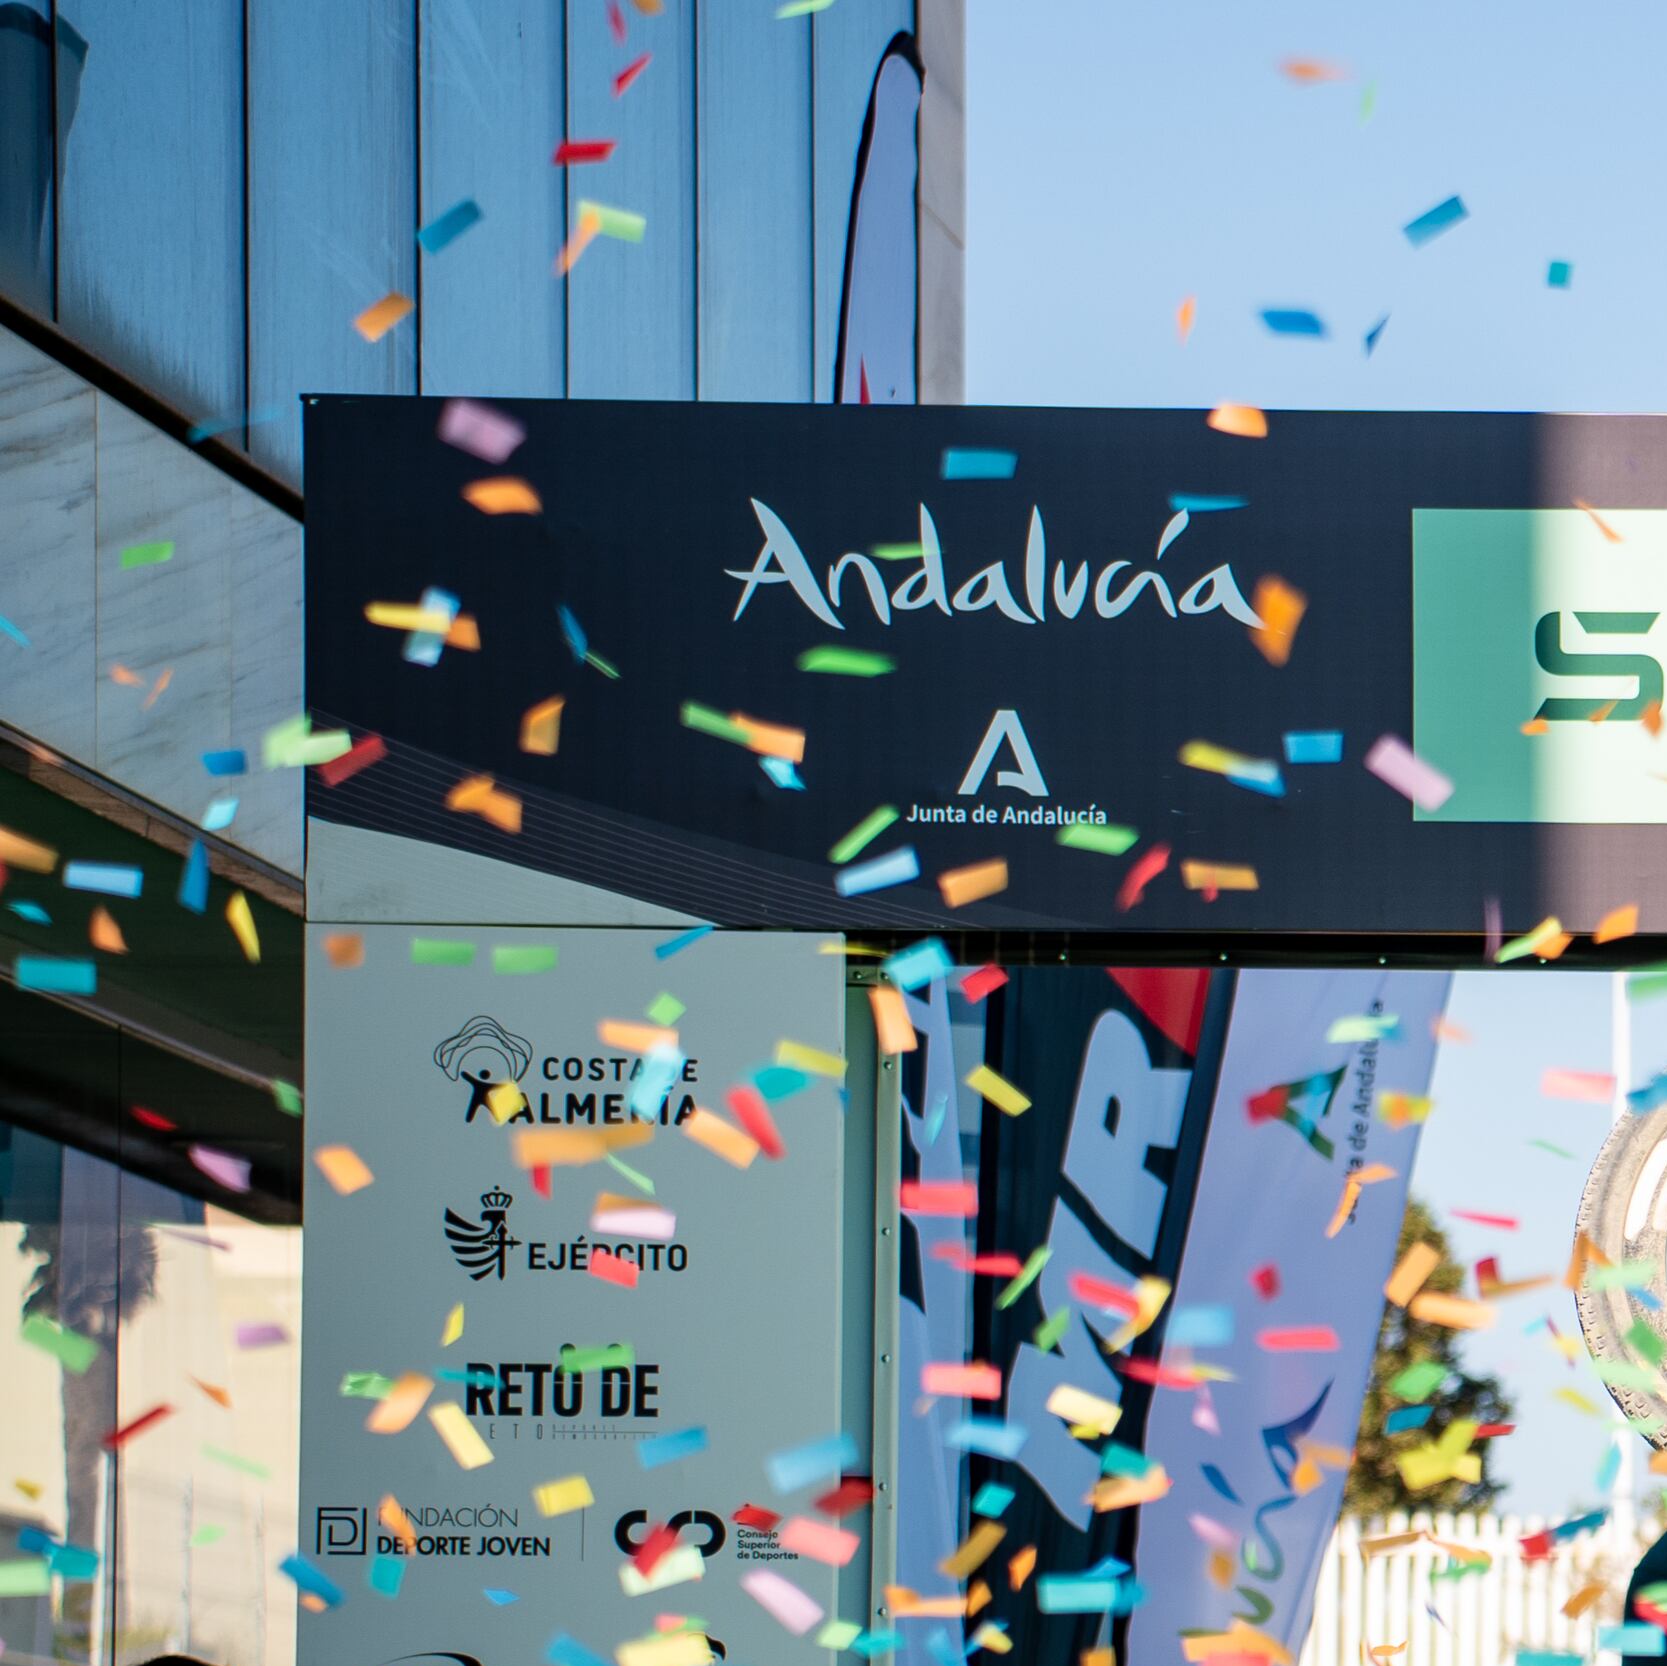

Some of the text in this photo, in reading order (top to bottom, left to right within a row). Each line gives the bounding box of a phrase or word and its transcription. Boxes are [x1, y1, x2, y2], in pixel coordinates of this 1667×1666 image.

[723, 496, 1266, 631] Andalucía
[906, 801, 1107, 827] Junta de Andalucía
[508, 1084, 698, 1126] ALMEÍA
[477, 1535, 550, 1557] JOVEN
[737, 1539, 781, 1552] Superior
[737, 1551, 799, 1562] de Deportes
